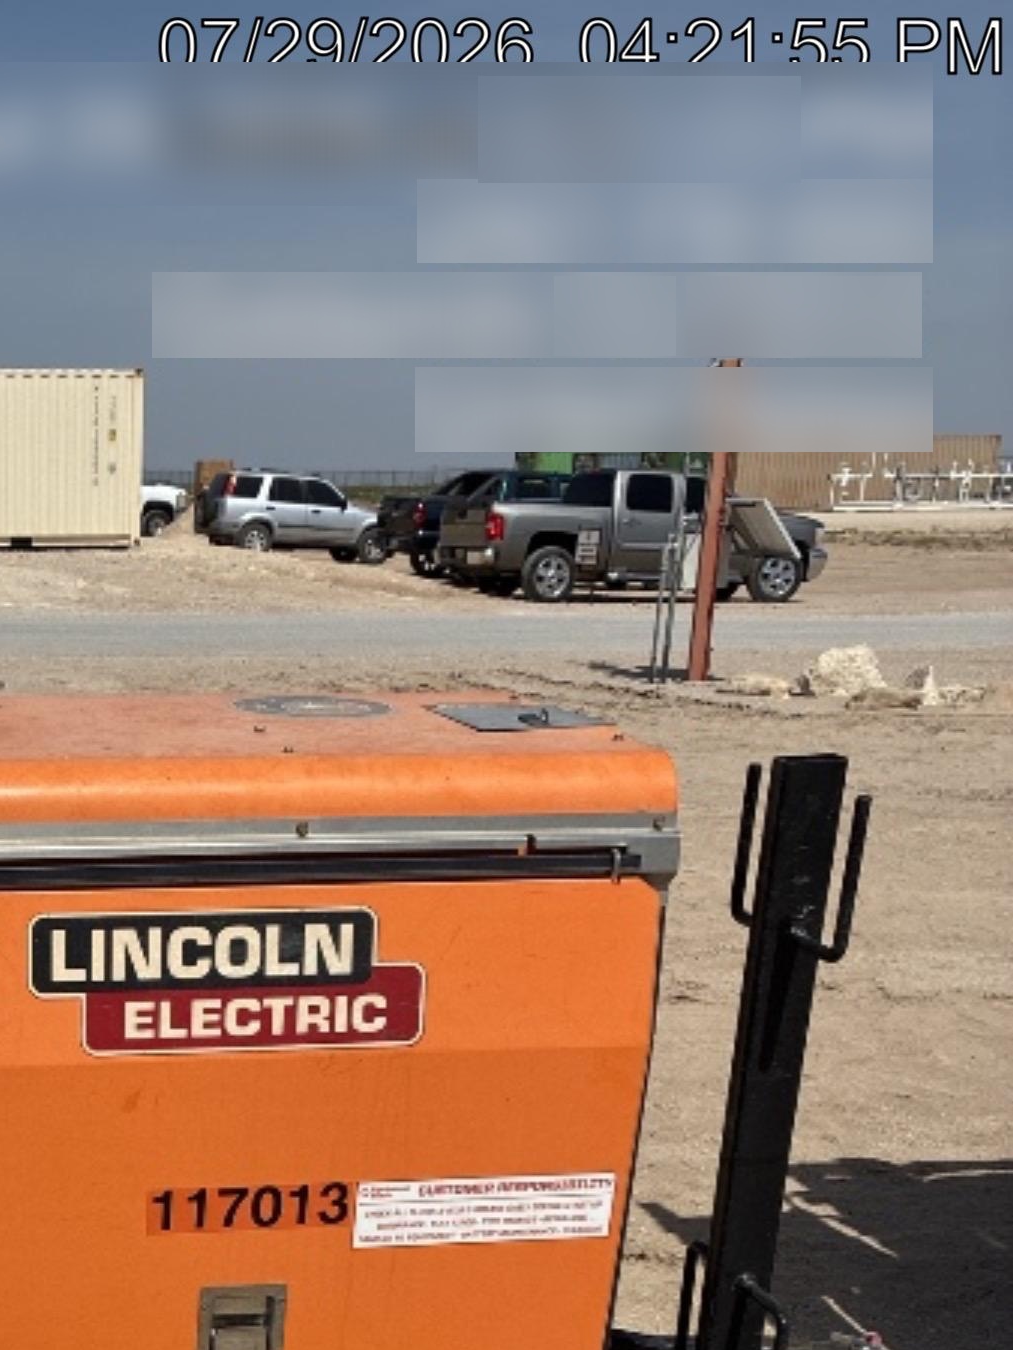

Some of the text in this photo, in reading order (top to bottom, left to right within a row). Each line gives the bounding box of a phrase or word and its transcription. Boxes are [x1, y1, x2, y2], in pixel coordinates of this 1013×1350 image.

[50, 923, 355, 983] LINCOLN
[123, 994, 388, 1040] ELECTRIC
[152, 1181, 348, 1231] 117013
